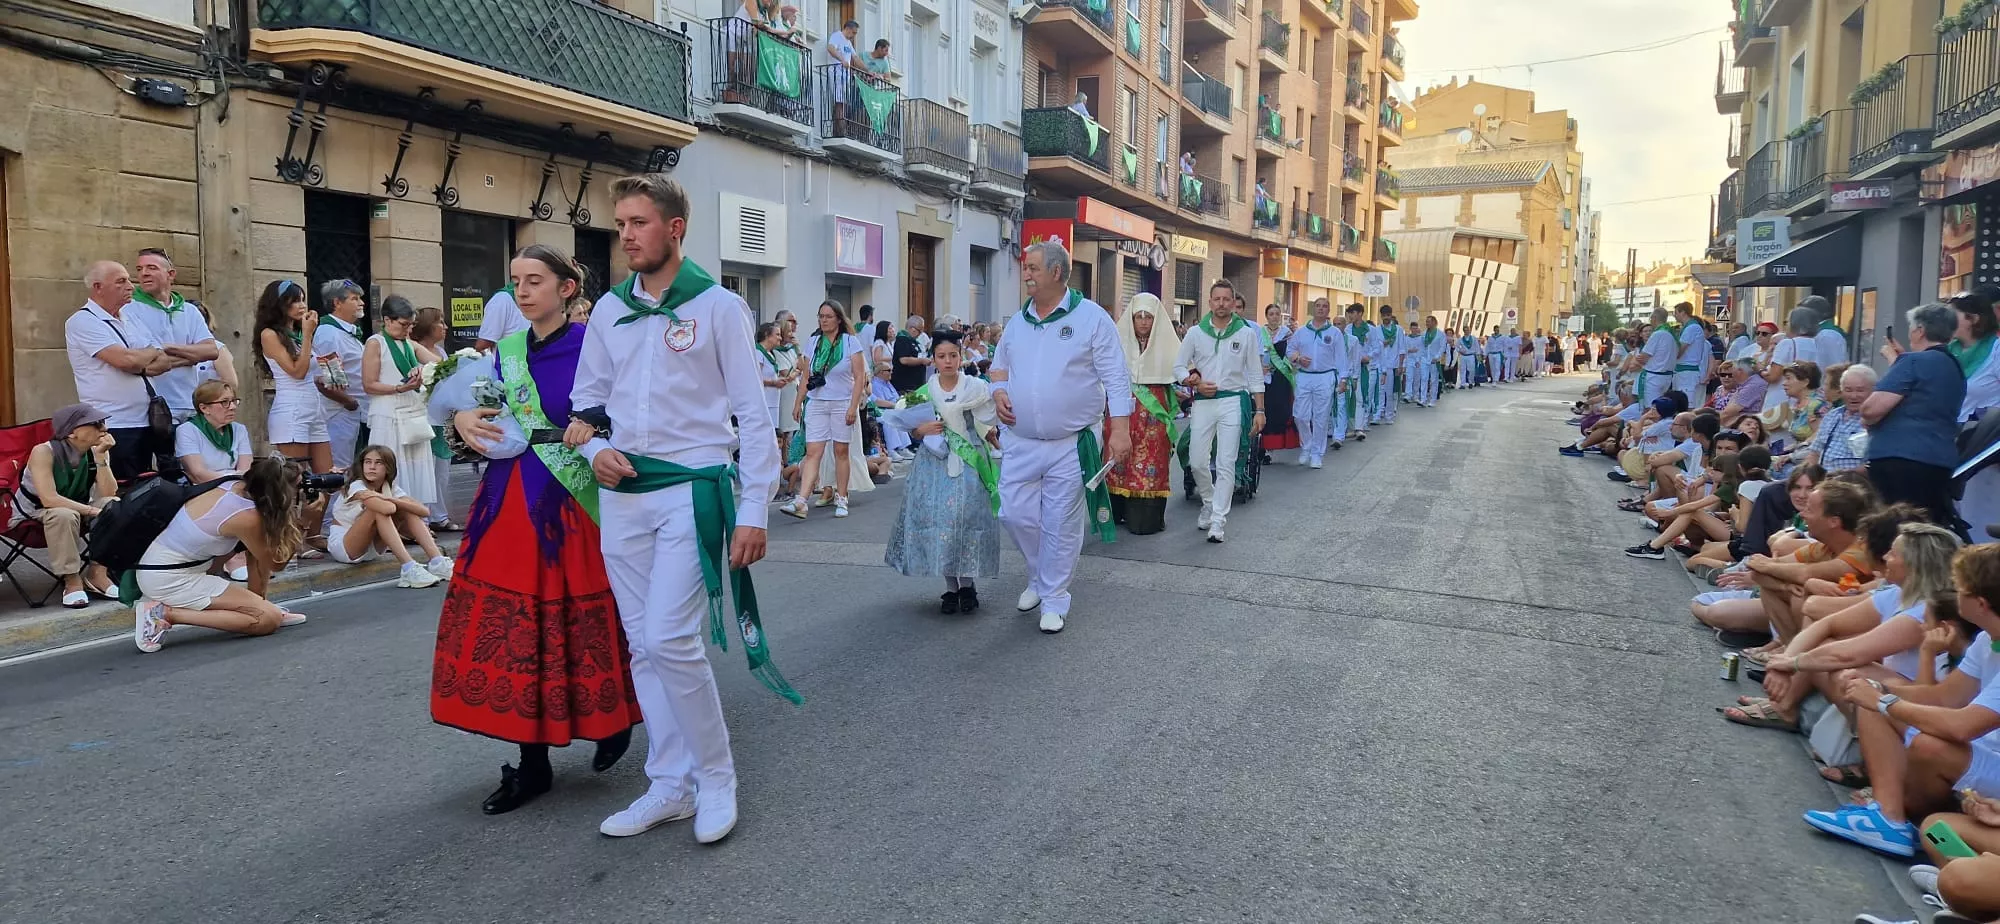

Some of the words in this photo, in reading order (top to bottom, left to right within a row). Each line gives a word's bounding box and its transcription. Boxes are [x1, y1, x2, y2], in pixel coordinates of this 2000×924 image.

[486, 176, 493, 186] 51
[1746, 243, 1782, 252] Aragón
[1322, 266, 1352, 288] MICAELA
[453, 304, 472, 312] LOCAL
[454, 313, 482, 321] ALQUILER
